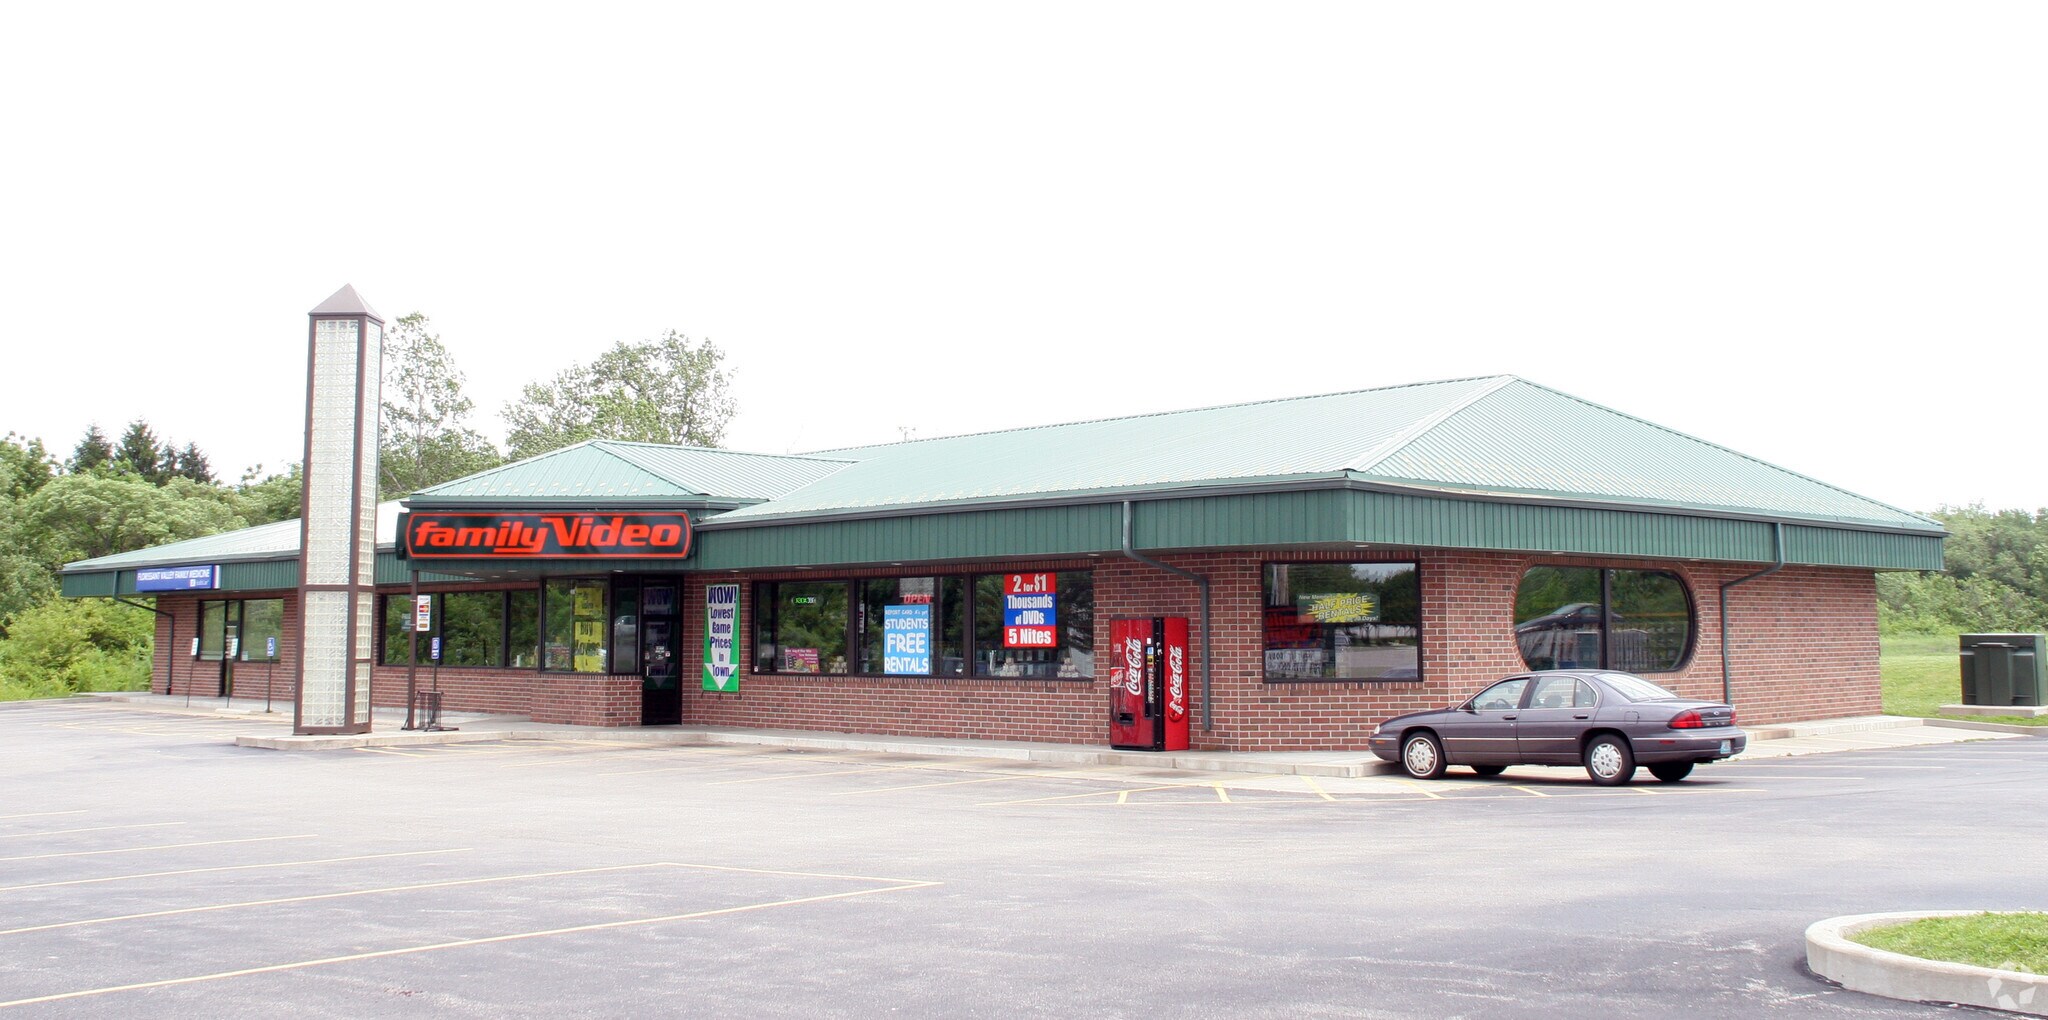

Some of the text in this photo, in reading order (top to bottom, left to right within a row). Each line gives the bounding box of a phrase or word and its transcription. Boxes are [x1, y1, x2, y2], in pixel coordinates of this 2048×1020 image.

[1013, 574, 1047, 592] 2 for $1
[708, 586, 737, 604] WOW!
[903, 594, 931, 604] OPEN
[1007, 594, 1053, 609] Thousands
[1310, 595, 1368, 612] HALF PRICE
[710, 607, 734, 619] Lowest
[1015, 610, 1045, 625] of DVDs
[1318, 605, 1362, 620] RENTALS
[712, 622, 731, 634] Game
[884, 618, 929, 630] STUDENTS
[710, 637, 733, 649] Prices
[887, 632, 926, 654] FREE
[1008, 628, 1052, 645] 5 Nites
[884, 656, 929, 673] RENTALS
